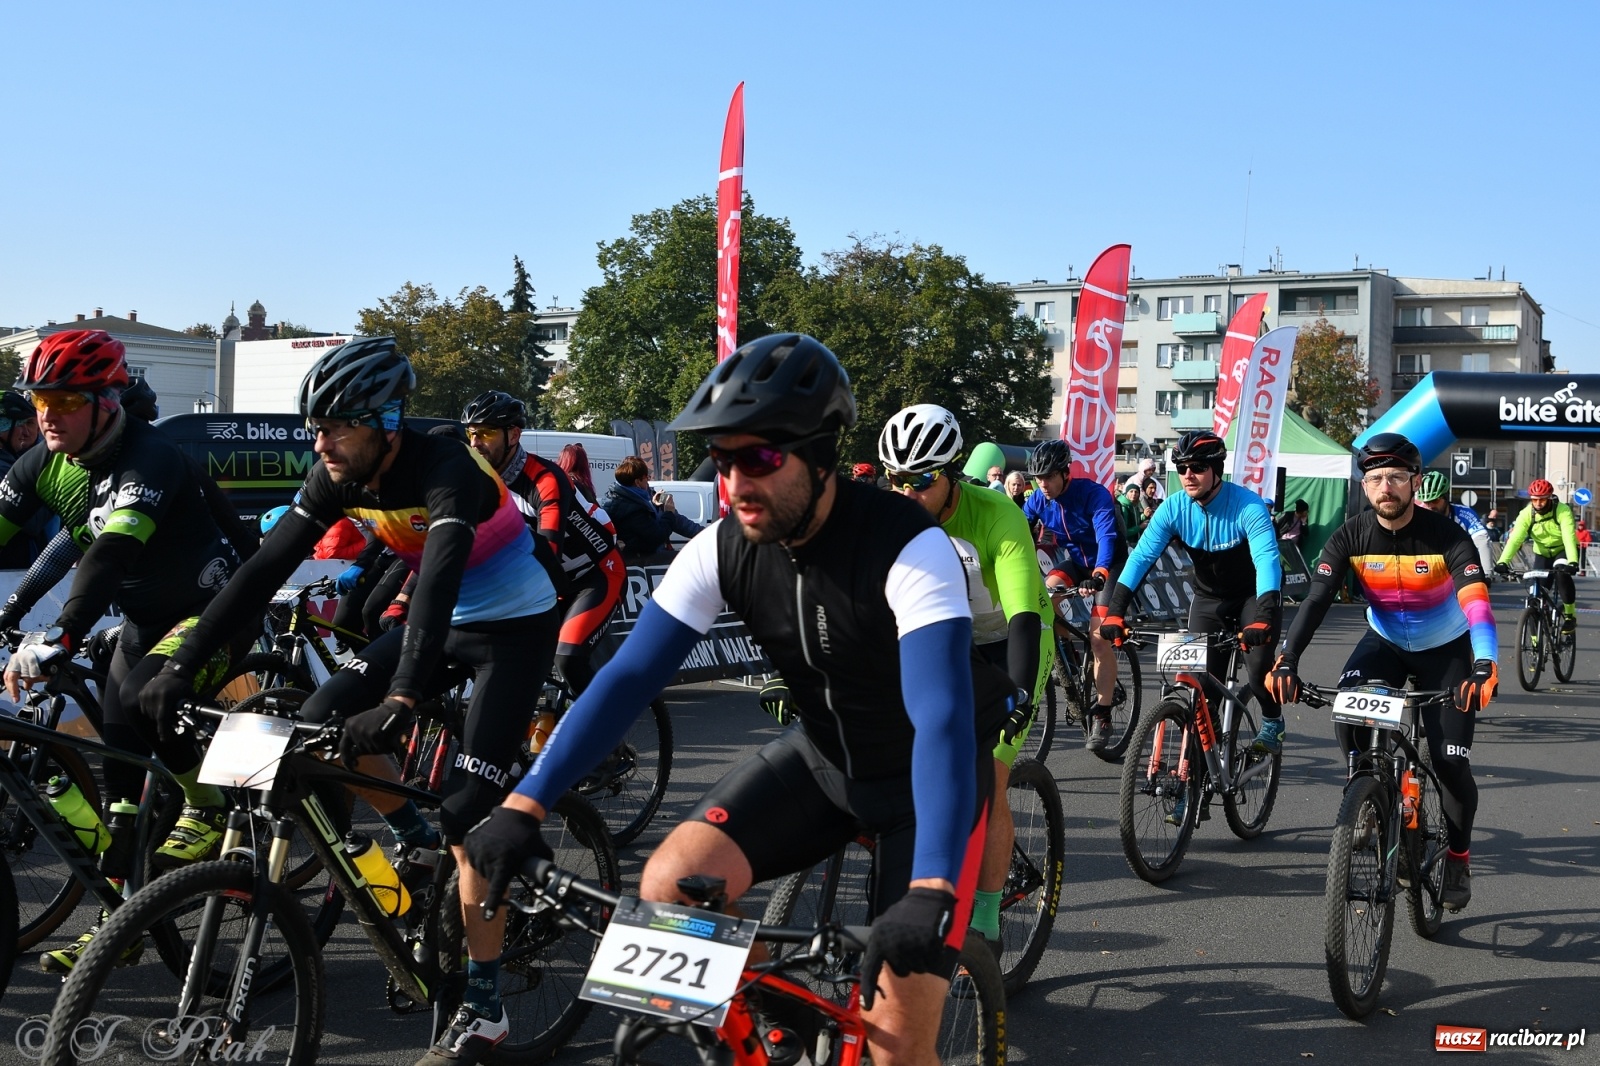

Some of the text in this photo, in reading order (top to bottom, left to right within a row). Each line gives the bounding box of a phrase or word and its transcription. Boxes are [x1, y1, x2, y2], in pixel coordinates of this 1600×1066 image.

[1500, 396, 1557, 422] bike
[247, 422, 288, 440] bike
[208, 450, 314, 476] MTBM
[129, 484, 164, 502] kiwi
[567, 510, 608, 553] SPECIALIZED
[816, 604, 832, 654] ROGELLI
[679, 638, 720, 670] NIAMY
[1345, 696, 1391, 714] 2095
[1049, 860, 1063, 917] MAXXIS
[613, 943, 711, 990] 2721
[234, 957, 257, 1023] AXON
